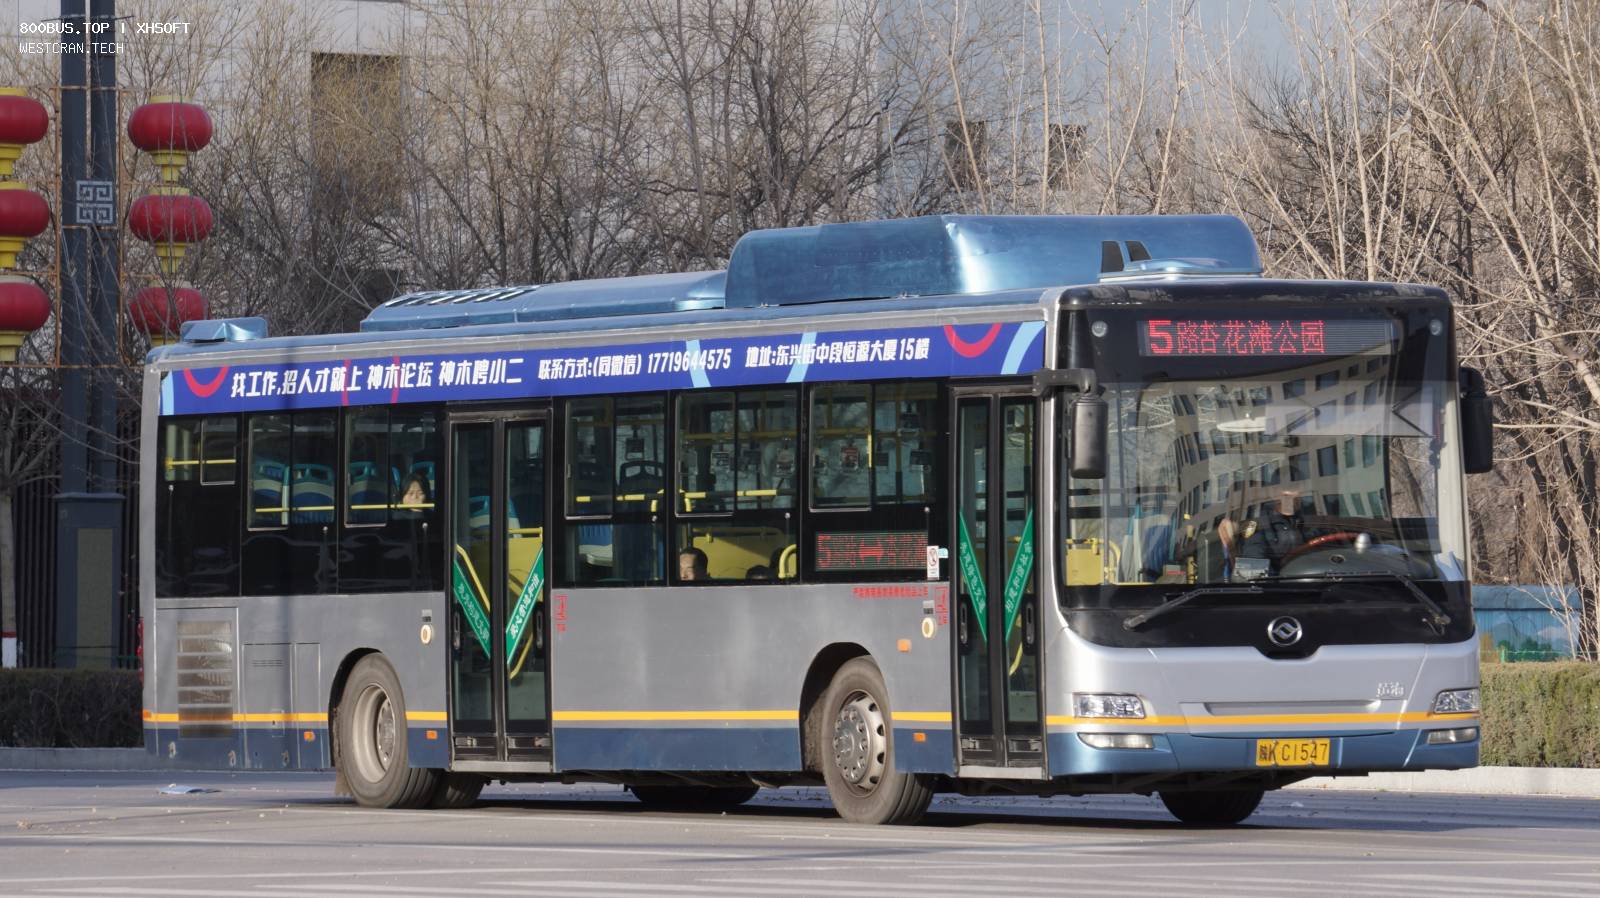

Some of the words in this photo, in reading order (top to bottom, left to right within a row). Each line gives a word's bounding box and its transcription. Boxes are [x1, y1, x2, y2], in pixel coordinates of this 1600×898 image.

[1148, 319, 1325, 354] 5路杏花滩公园
[367, 361, 434, 390] 神木论坛
[438, 358, 524, 386] 神木聘小二
[647, 348, 732, 374] 17719644575
